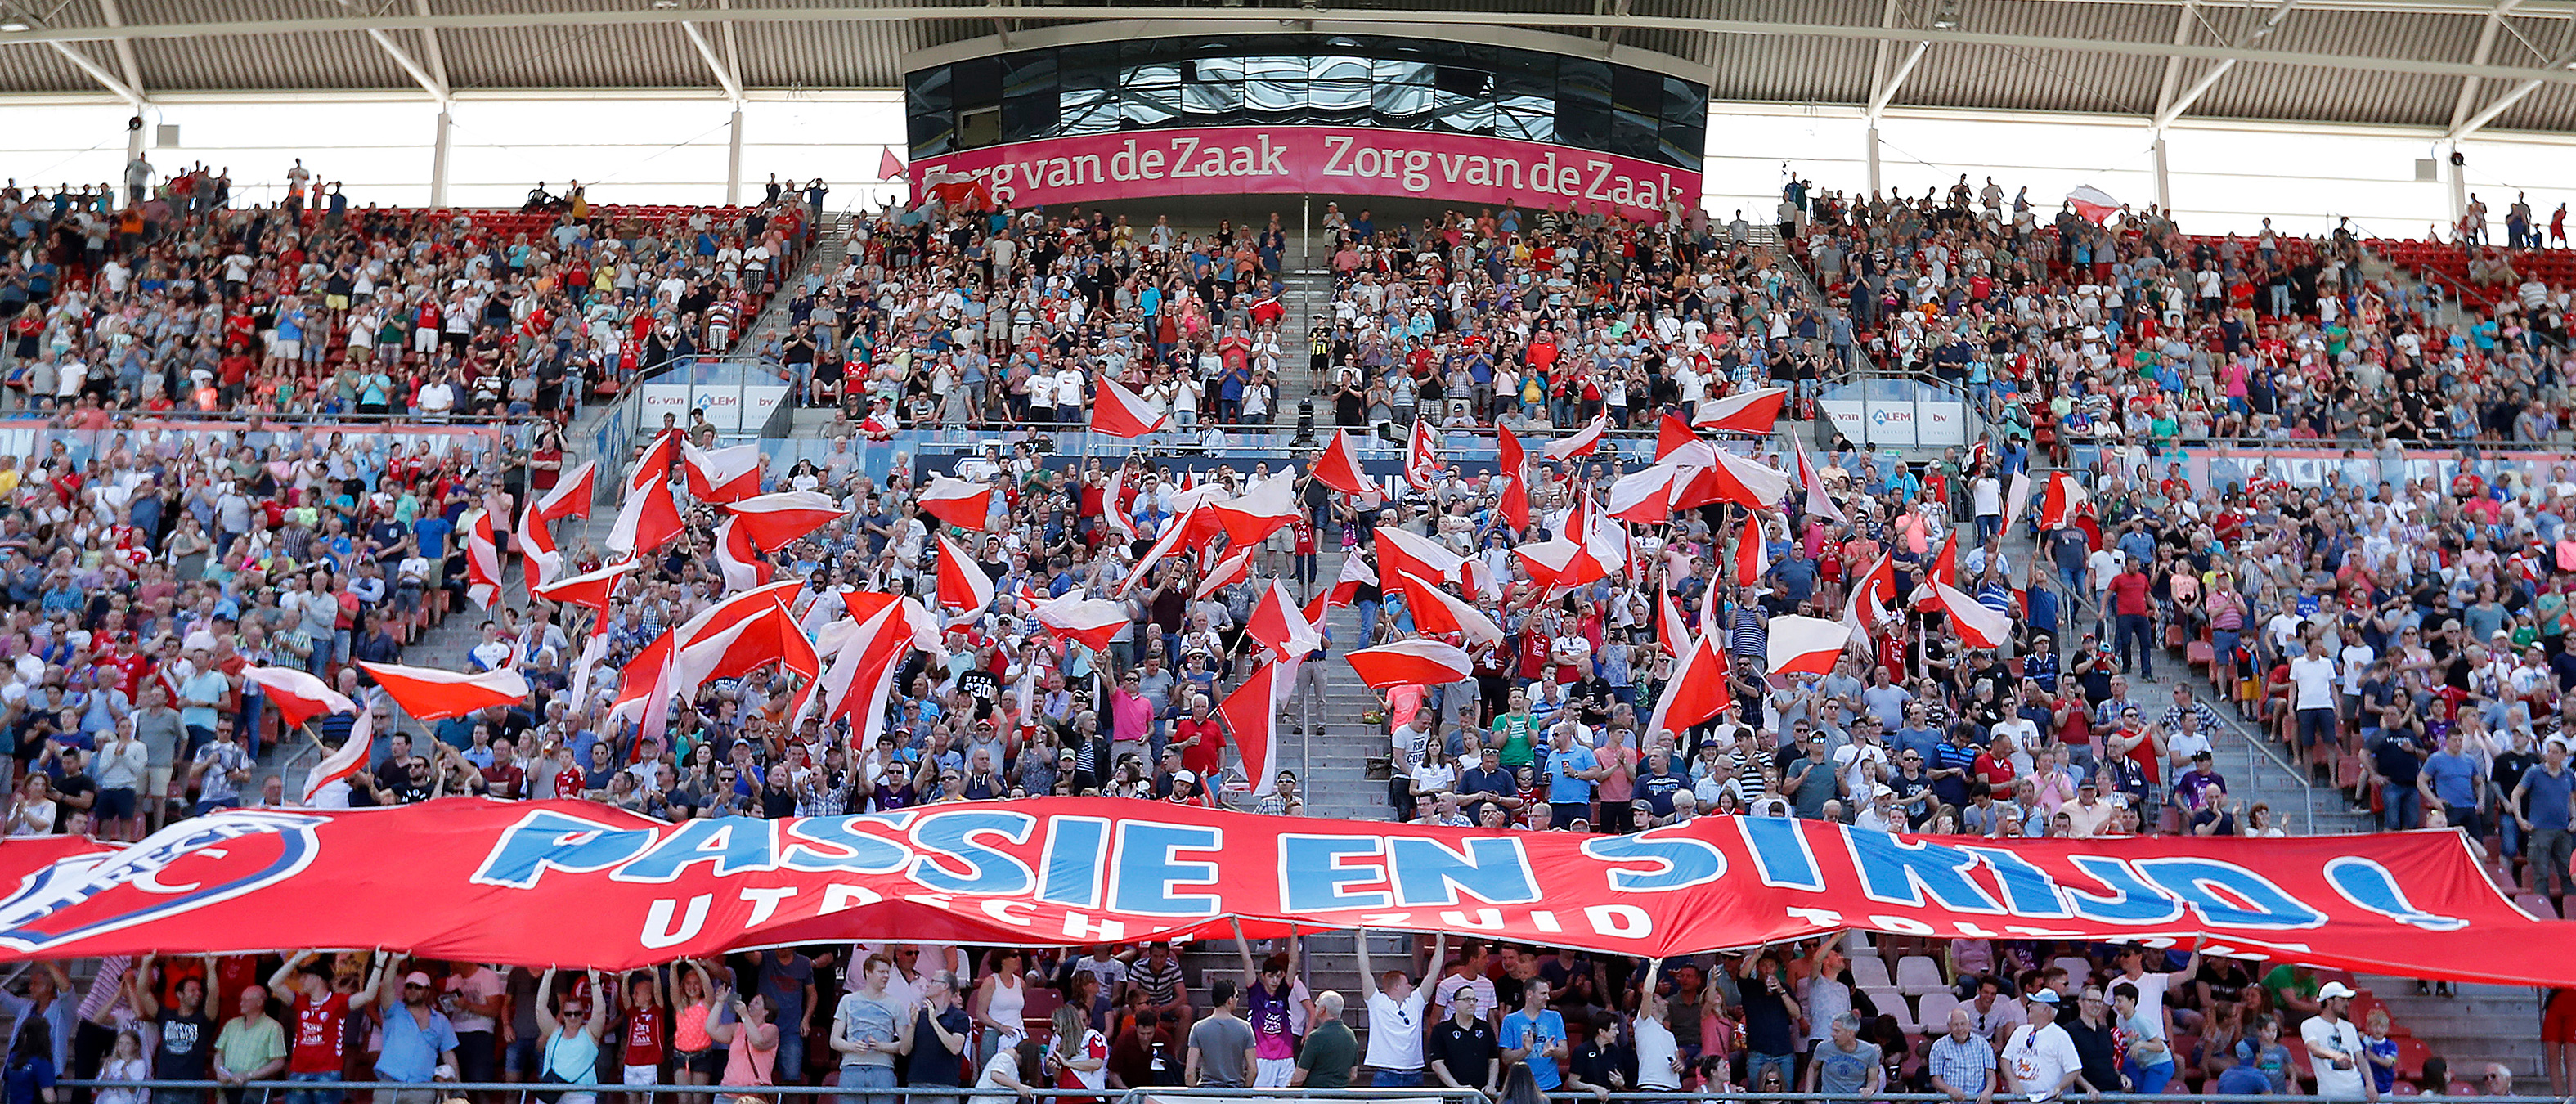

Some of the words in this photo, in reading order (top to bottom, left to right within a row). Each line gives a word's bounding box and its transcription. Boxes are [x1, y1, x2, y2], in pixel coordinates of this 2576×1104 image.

[922, 164, 1016, 205] Zrg
[1020, 154, 1105, 189] van
[1111, 139, 1165, 181] de
[1171, 134, 1289, 178] Zaak
[1322, 136, 1432, 192] Zorg
[1437, 152, 1524, 189] van
[1530, 152, 1581, 196] de
[663, 397, 684, 406] van
[700, 396, 737, 406] ALEM
[759, 397, 774, 406] bv
[1838, 413, 1860, 421] van
[1874, 411, 1911, 421] ALEM
[1933, 413, 1947, 422] bv
[966, 676, 992, 684] UTCA
[1413, 740, 1425, 751] RIP
[1407, 753, 1425, 763] CUR
[470, 809, 1223, 916] PASSIE
[1277, 832, 1544, 915] EN
[1360, 904, 1654, 940] ZUID
